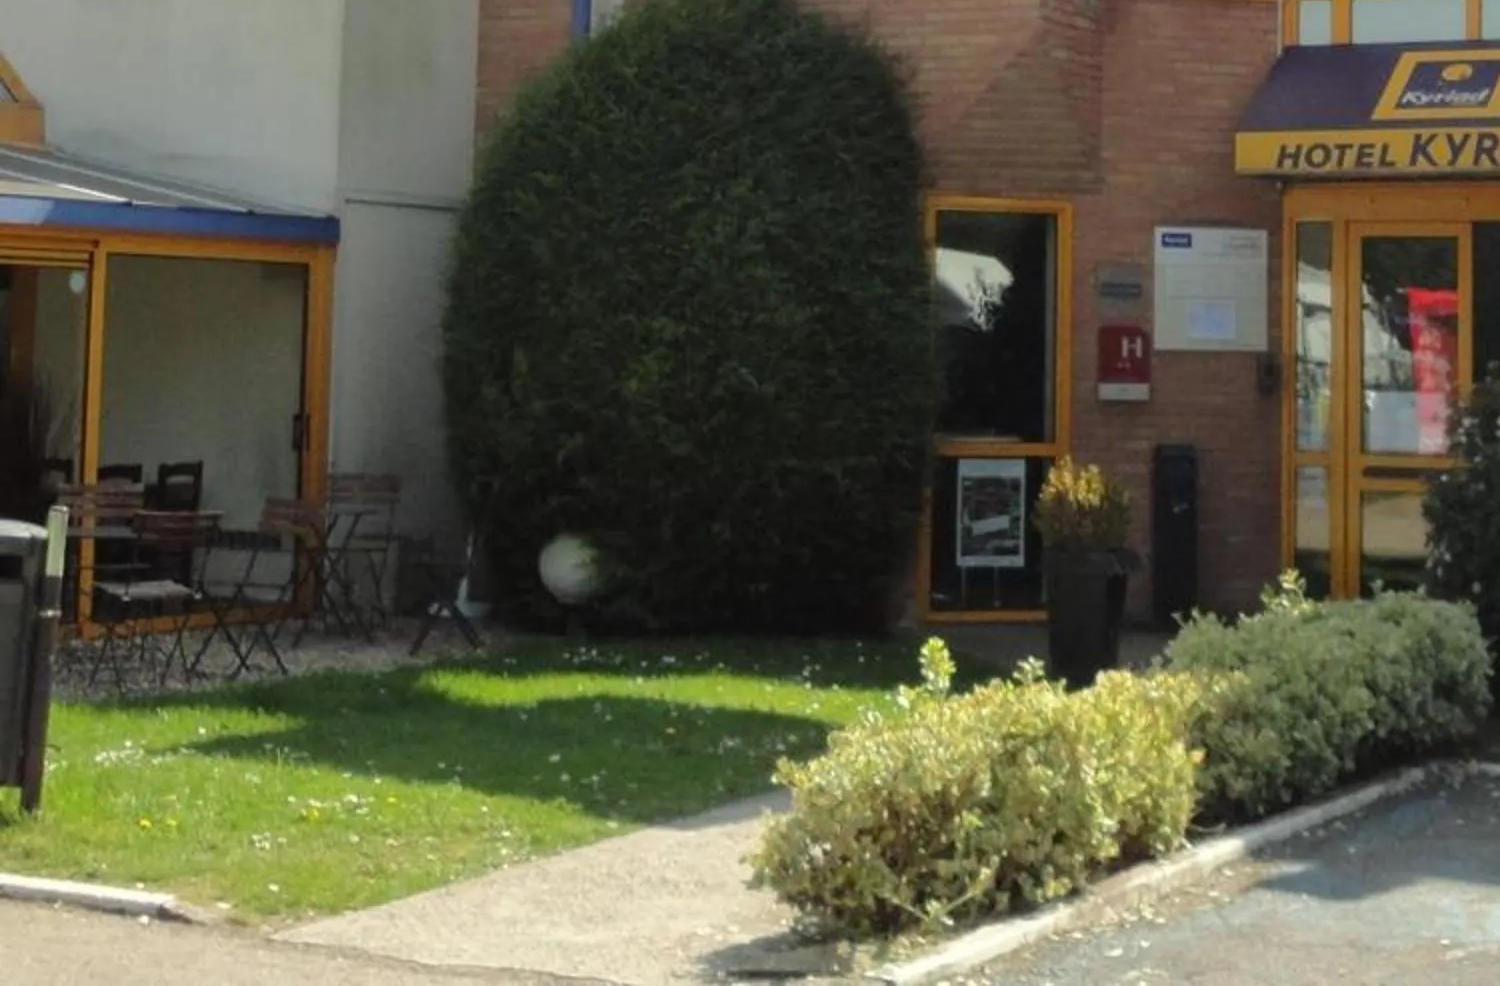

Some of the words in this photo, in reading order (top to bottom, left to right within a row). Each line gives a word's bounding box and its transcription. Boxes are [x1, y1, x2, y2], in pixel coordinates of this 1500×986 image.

[1402, 87, 1490, 106] Kyriad
[1276, 143, 1396, 169] HOTEL
[1121, 335, 1143, 358] H
